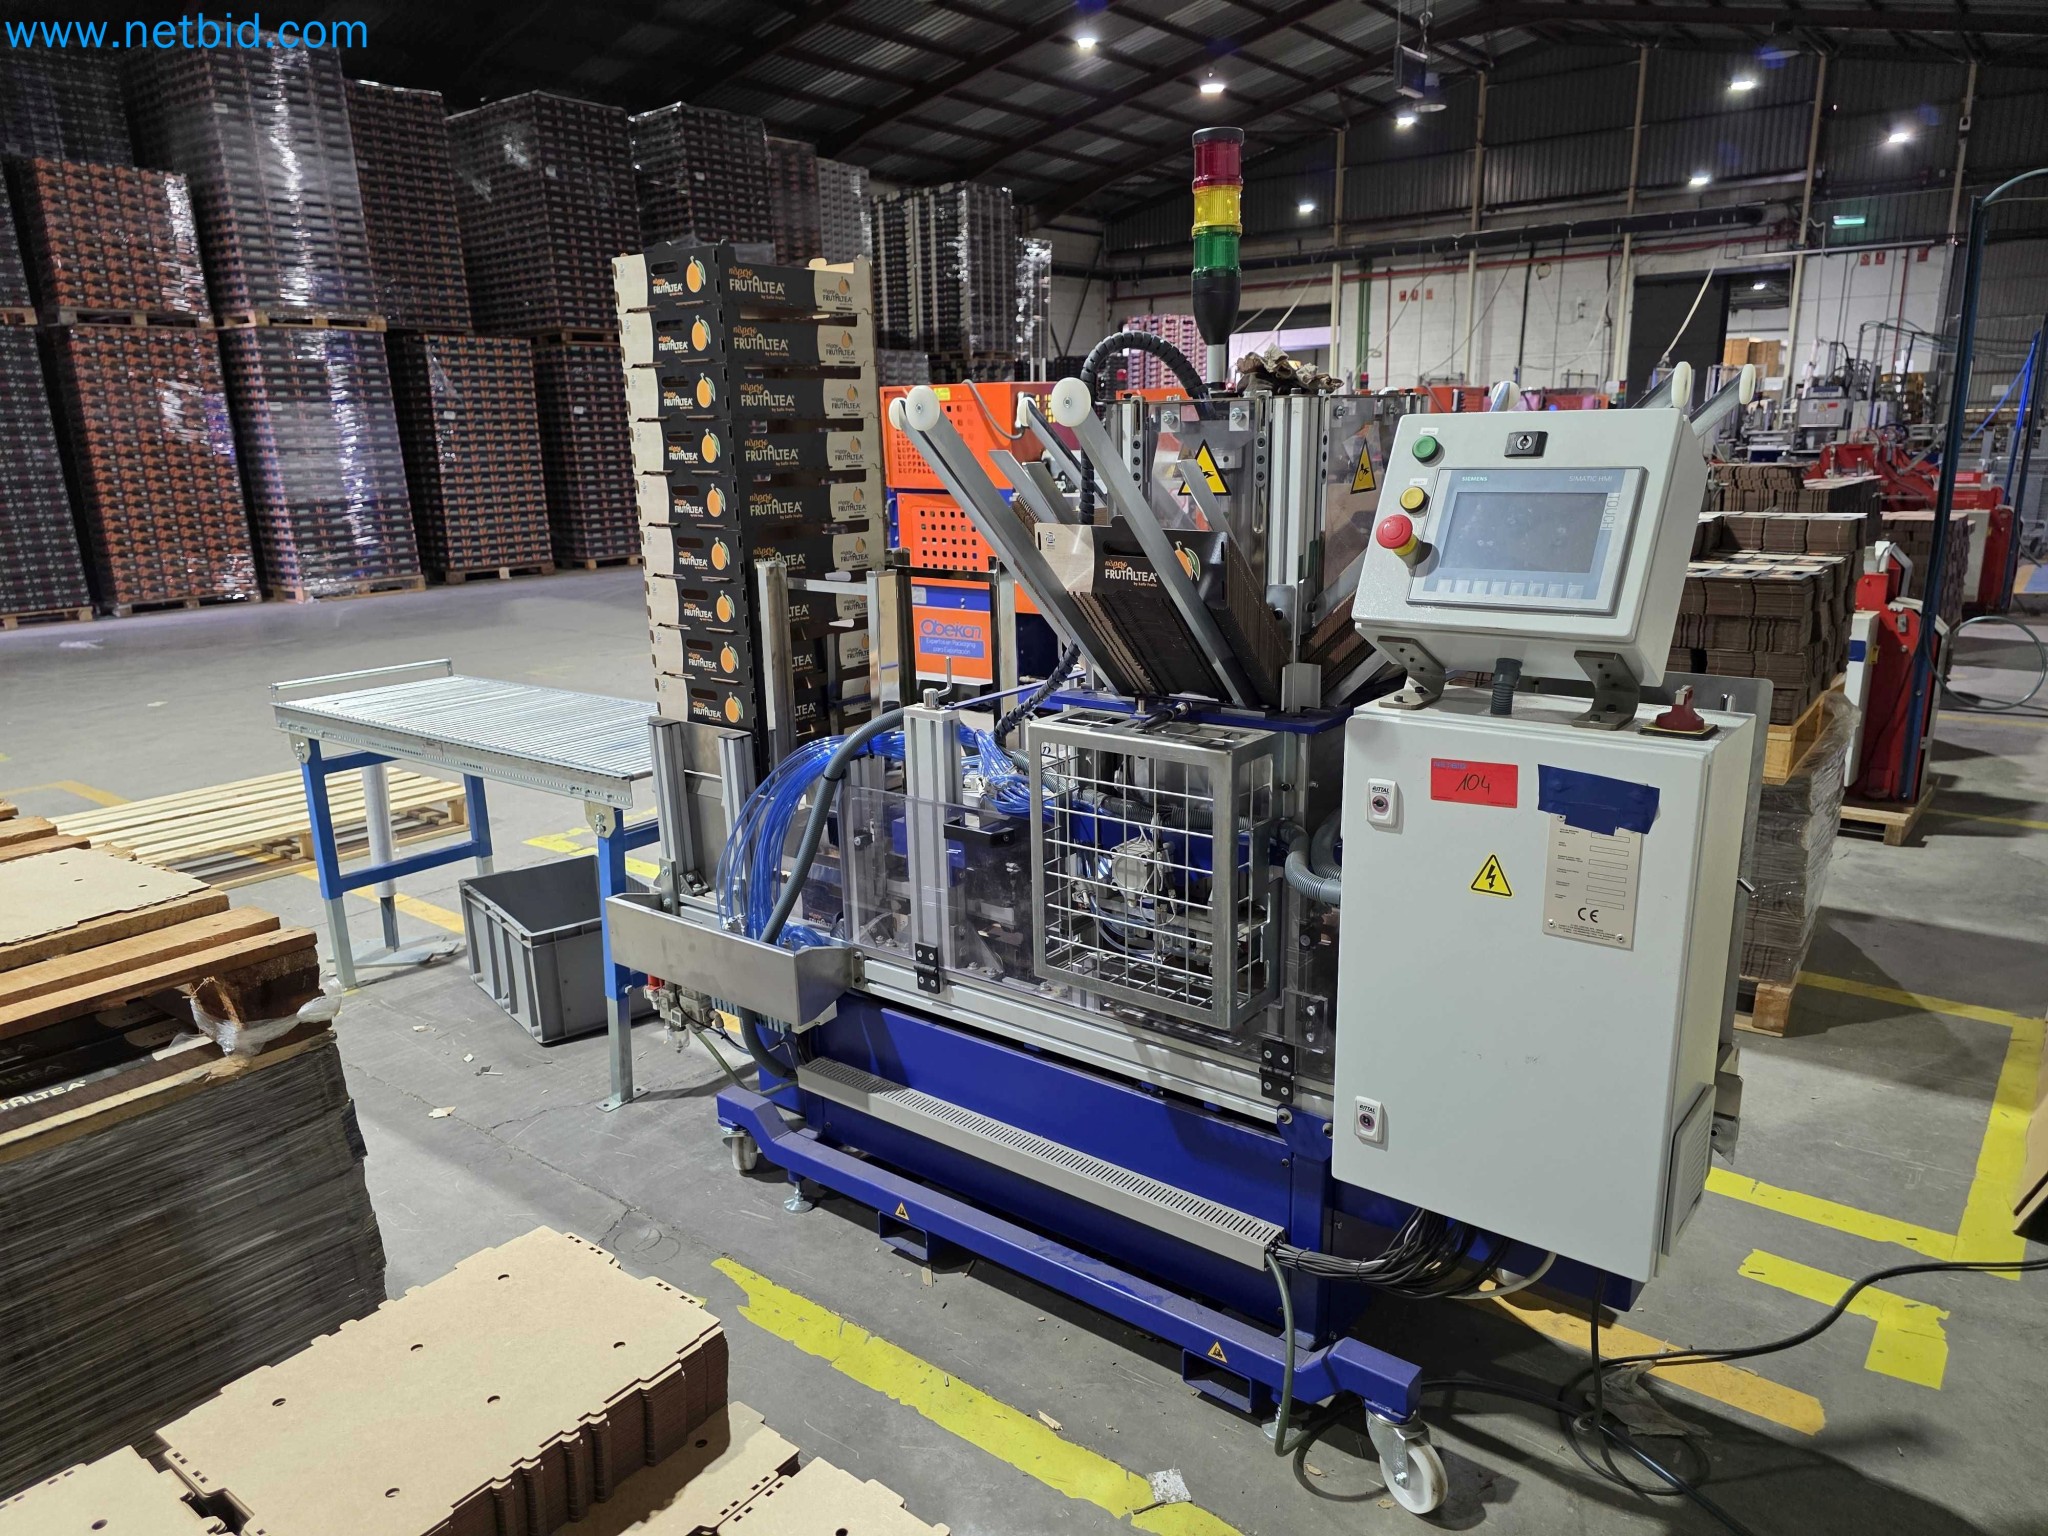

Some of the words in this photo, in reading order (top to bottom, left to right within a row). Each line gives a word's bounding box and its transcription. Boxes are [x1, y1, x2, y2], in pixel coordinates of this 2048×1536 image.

[729, 276, 784, 294] FRUTALTEA
[734, 334, 788, 351] FRUTALTEA
[741, 390, 794, 406] FRUTALTEA
[746, 445, 798, 462] FRUTALTEA
[750, 499, 802, 516] FRUTALTEA
[1602, 494, 1620, 530] TOUCH
[1105, 567, 1156, 582] FRUTALTEA
[1456, 773, 1490, 796] 104
